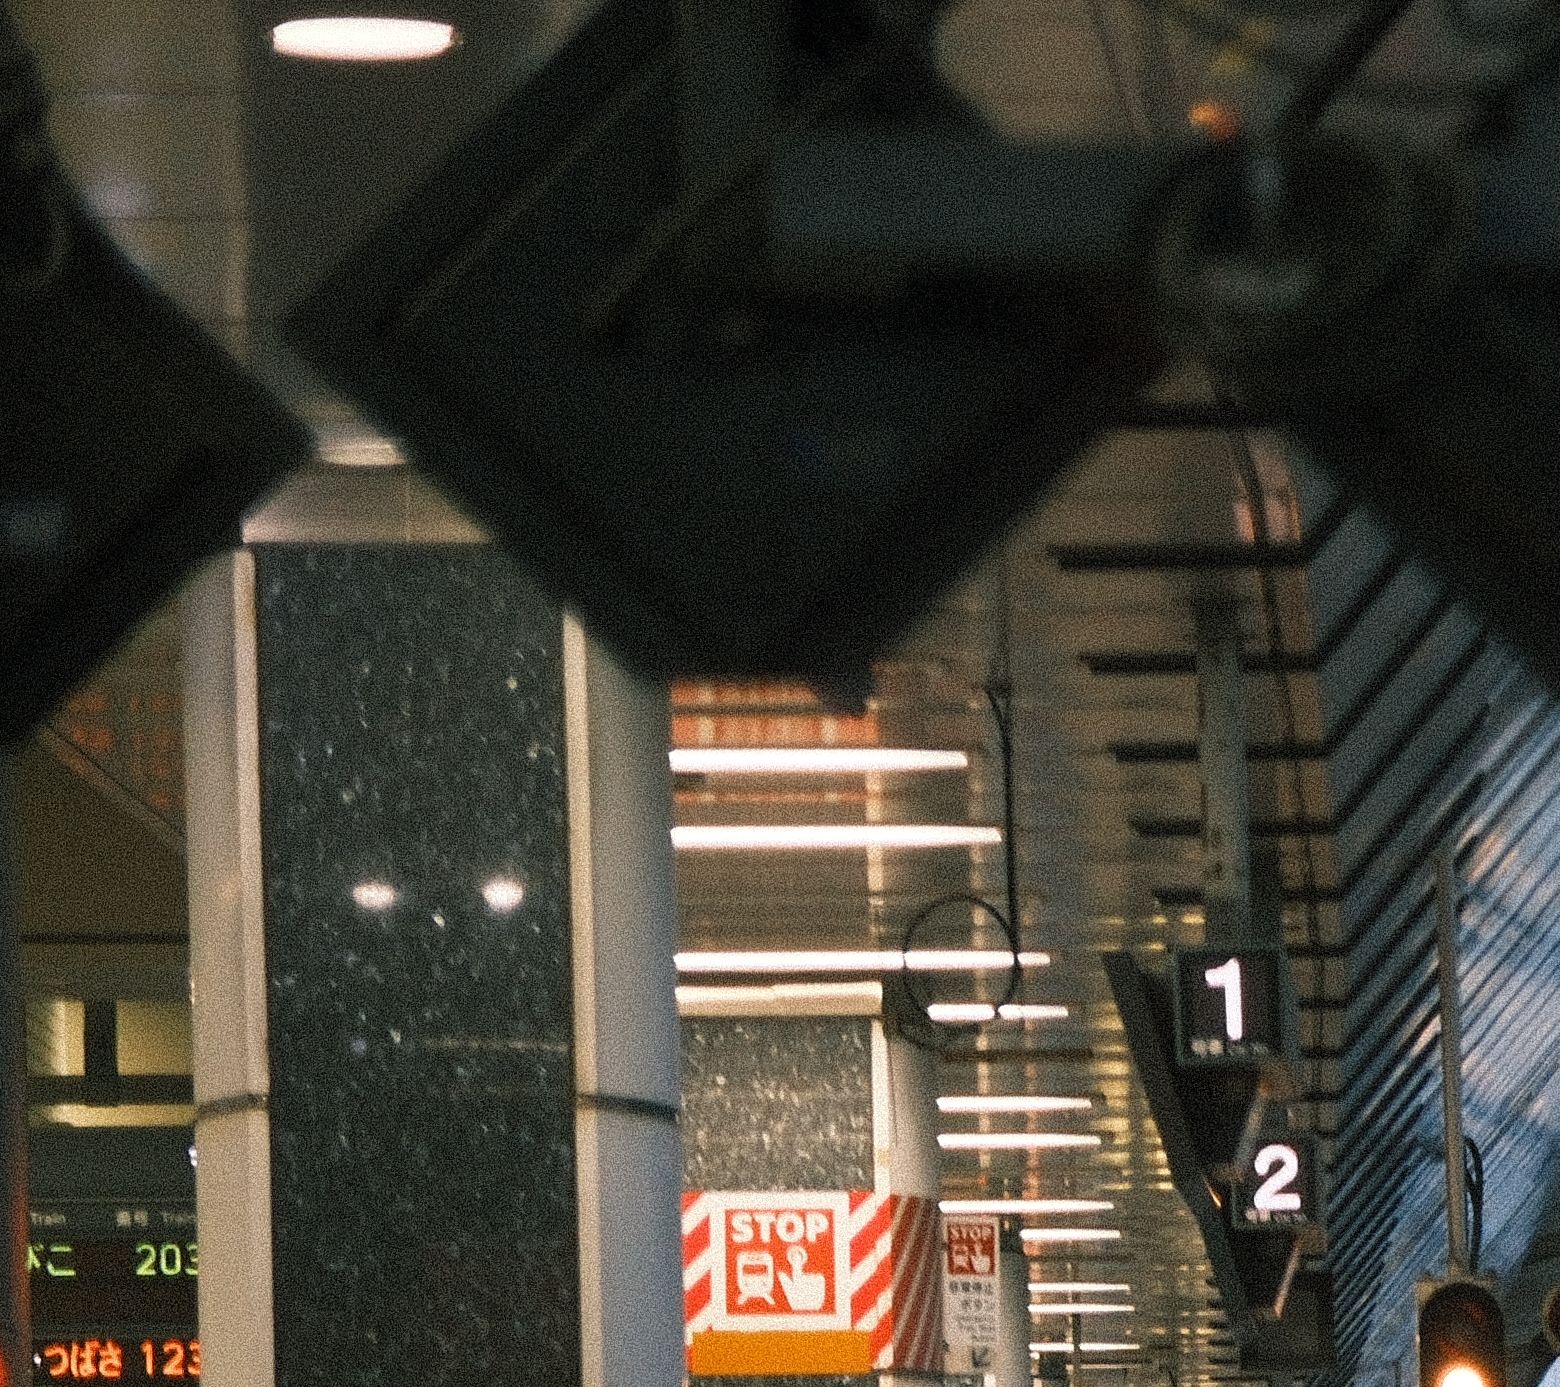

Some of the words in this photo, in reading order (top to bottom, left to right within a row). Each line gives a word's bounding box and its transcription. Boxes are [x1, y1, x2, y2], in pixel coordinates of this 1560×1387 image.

[1204, 957, 1243, 1041] 1
[1253, 1143, 1301, 1211] 2
[731, 1213, 830, 1244] STOP
[43, 1339, 123, 1379] つばさ
